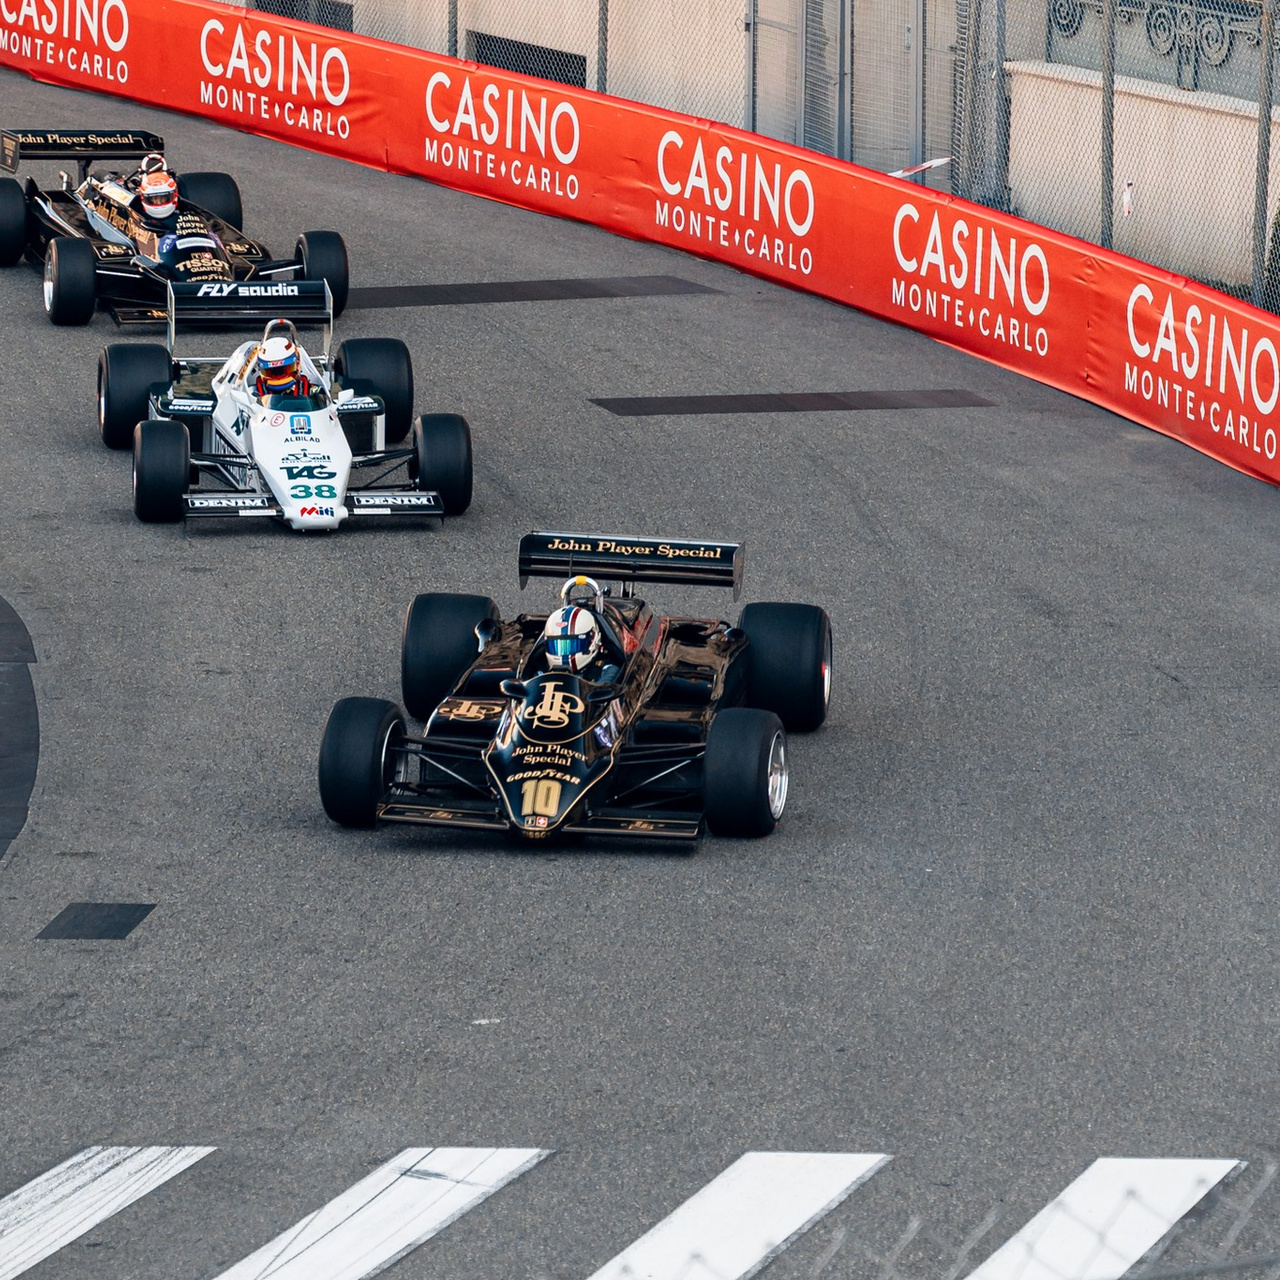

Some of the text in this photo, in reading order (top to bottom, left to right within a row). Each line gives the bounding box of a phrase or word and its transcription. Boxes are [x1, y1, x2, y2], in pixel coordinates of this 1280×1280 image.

[200, 18, 350, 106] CASINO
[425, 71, 580, 165] CASINO
[46, 134, 86, 145] Player
[88, 134, 134, 145] Special
[657, 130, 815, 237] CASINO
[177, 214, 200, 222] John
[176, 228, 208, 236] Special
[175, 259, 230, 271] TISSOT
[893, 203, 1050, 316] CASINO
[197, 283, 299, 296] FLY saudia
[1126, 283, 1280, 415] CASINO
[280, 465, 337, 480] TAG
[291, 485, 337, 499] 38
[194, 499, 263, 507] DENIM
[359, 497, 429, 505] DENIM
[548, 539, 721, 558] John Player Special
[512, 745, 589, 761] John Player
[523, 755, 572, 766] Special
[521, 779, 562, 817] 10
